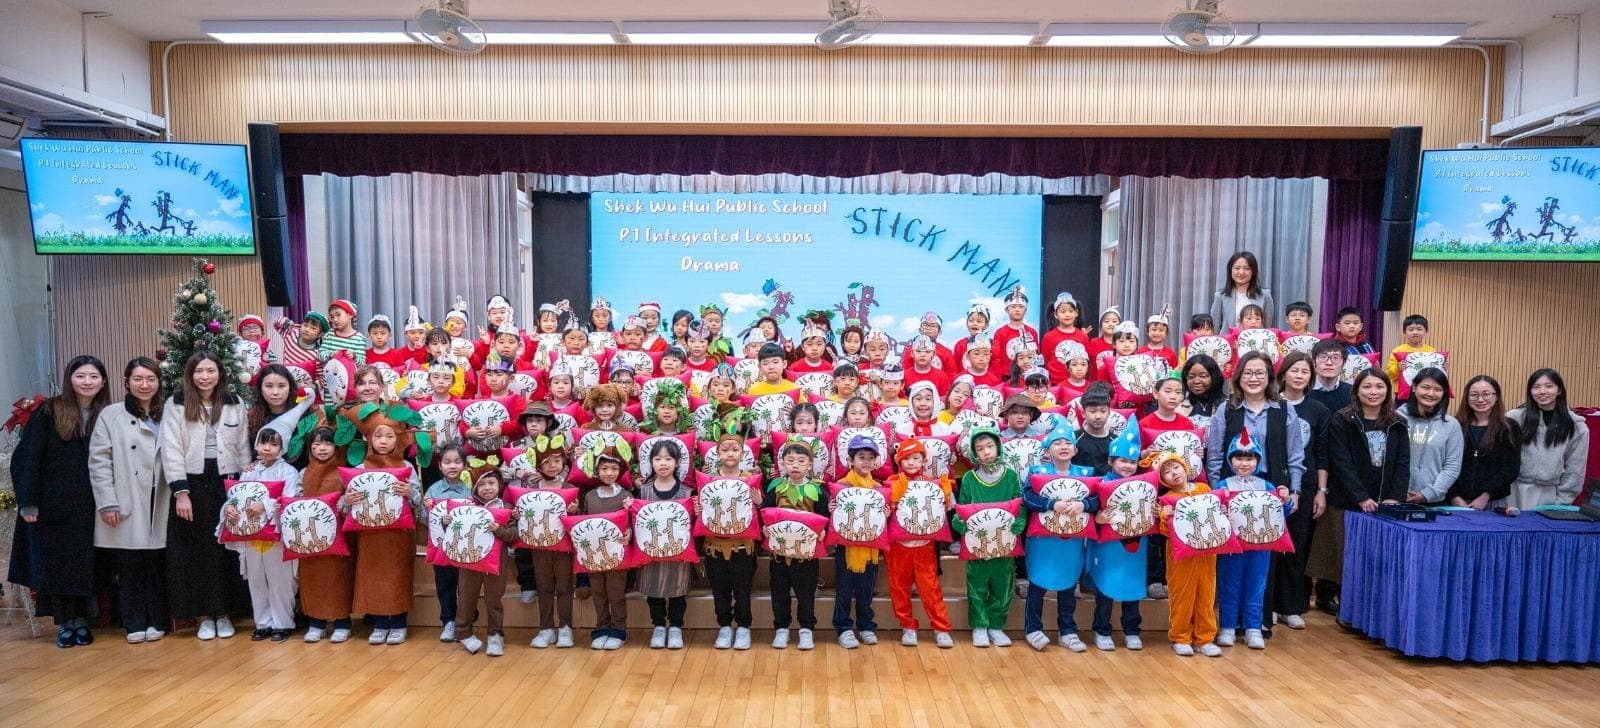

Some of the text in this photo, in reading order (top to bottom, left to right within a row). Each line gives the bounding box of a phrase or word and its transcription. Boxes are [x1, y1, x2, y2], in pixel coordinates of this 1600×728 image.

[86, 145, 113, 154] Public
[1484, 153, 1510, 162] Public
[1512, 152, 1542, 162] School
[152, 150, 241, 200] STICK MAN
[1496, 170, 1531, 178] Lessons
[1548, 156, 1600, 180] STICK
[603, 198, 828, 215] Shek Wu Hui Public School
[619, 228, 813, 248] P.1 Integrated Lessons
[844, 208, 1021, 298] STICK MAN
[681, 256, 739, 273] Drama
[1041, 481, 1067, 498] TICK
